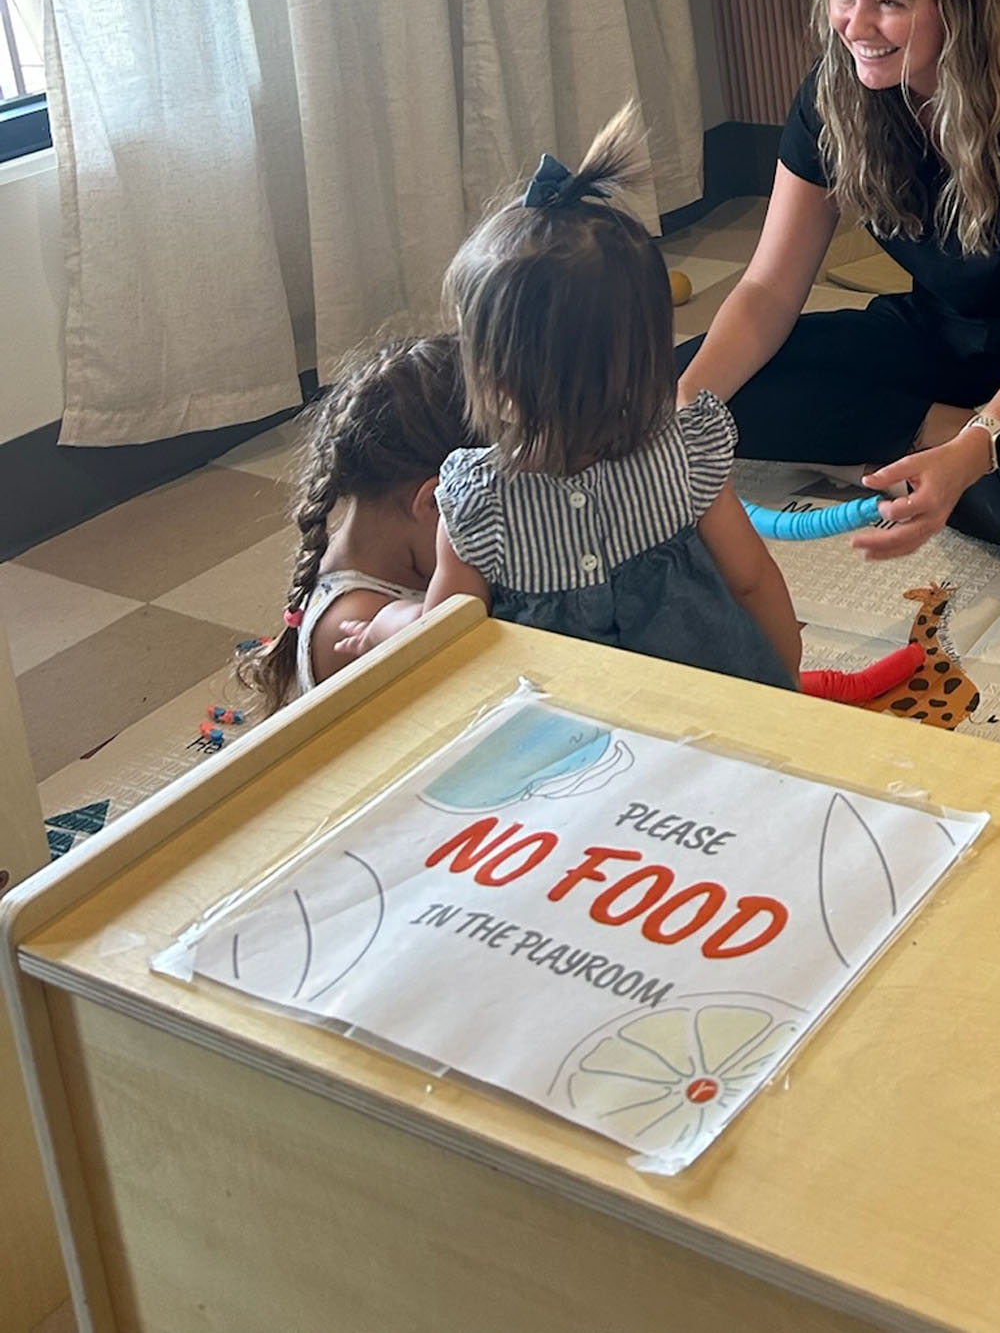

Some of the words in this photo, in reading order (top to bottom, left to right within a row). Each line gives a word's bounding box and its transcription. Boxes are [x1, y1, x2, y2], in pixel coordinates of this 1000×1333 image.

[615, 802, 737, 856] PLEASE
[424, 816, 559, 887] NO
[547, 846, 789, 959] FOOD
[410, 903, 464, 928] IN
[455, 911, 520, 948] THE
[510, 930, 675, 1008] PLAYROOM
